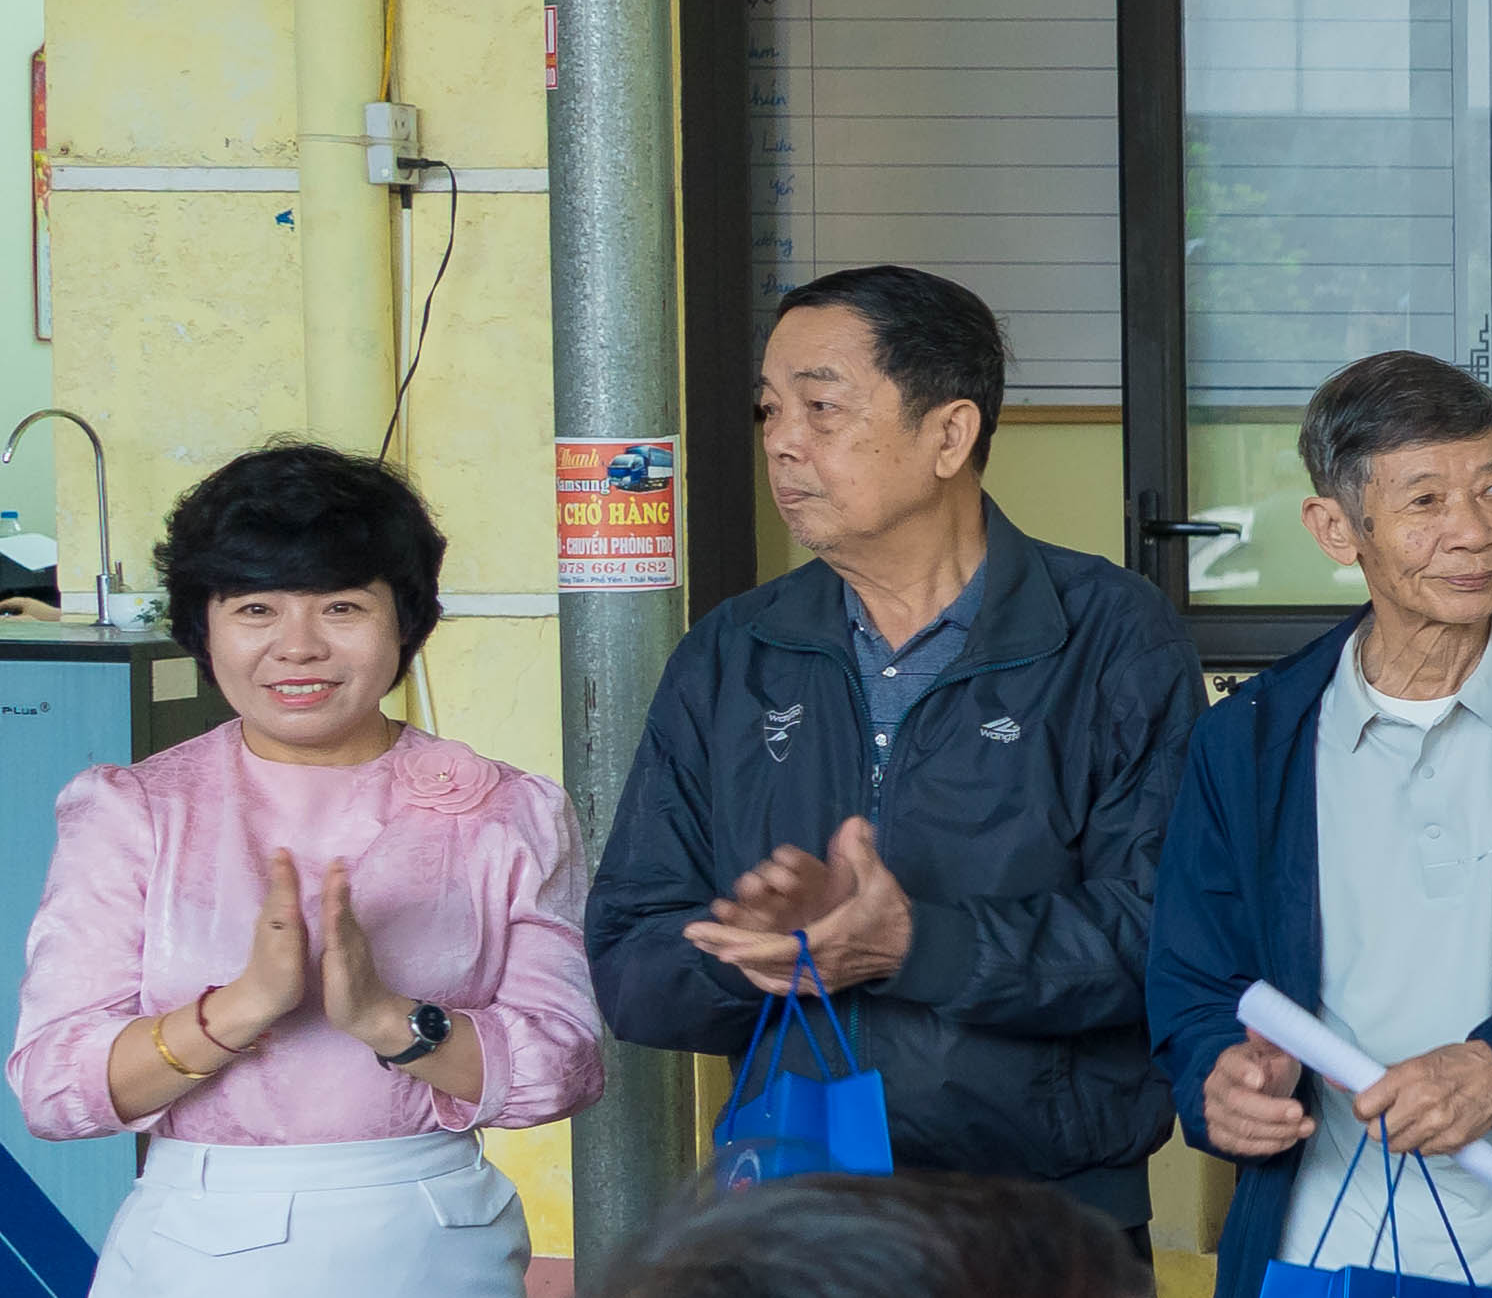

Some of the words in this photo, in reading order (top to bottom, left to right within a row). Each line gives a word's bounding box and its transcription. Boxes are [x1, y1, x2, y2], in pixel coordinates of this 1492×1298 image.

[565, 495, 602, 525] CHỞ
[609, 497, 670, 524] HÀNG
[611, 534, 653, 554] PHÒNG
[656, 536, 673, 557] TRỌ
[592, 563, 626, 573] 664
[635, 562, 667, 573] 682
